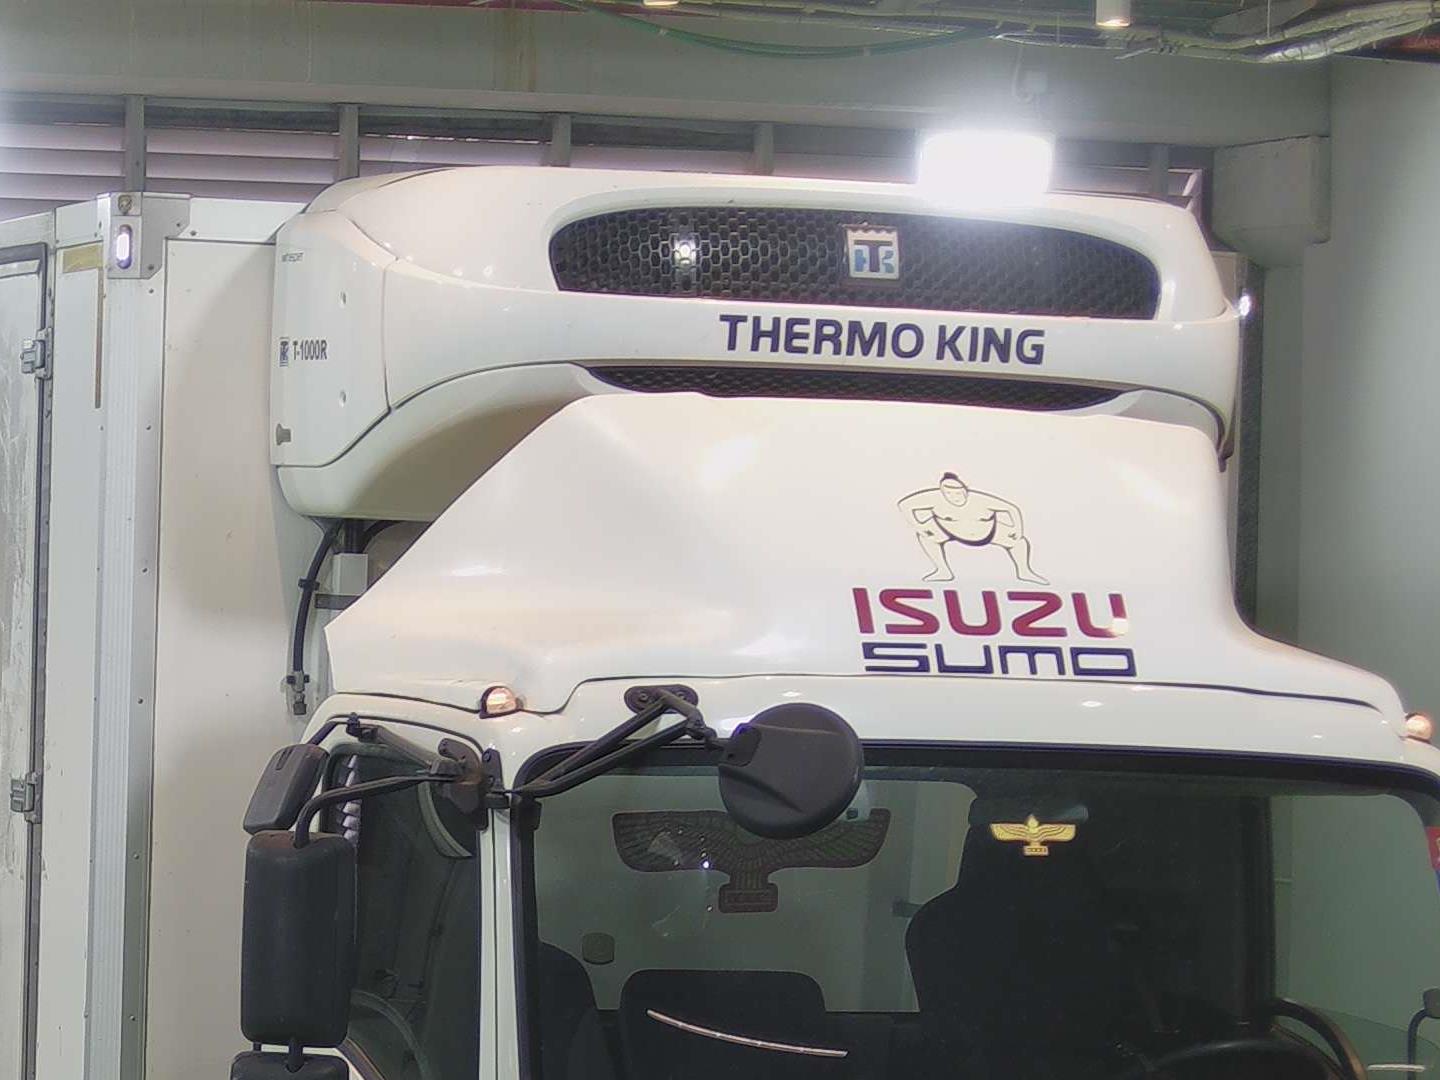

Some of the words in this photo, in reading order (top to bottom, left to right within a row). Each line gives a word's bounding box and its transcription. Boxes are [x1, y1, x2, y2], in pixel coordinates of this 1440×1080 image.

[292, 339, 328, 361] T-1000R
[719, 313, 925, 359] THERMO
[935, 324, 1046, 366] KING
[852, 587, 1129, 638] ISUZU
[861, 642, 1137, 677] SUMO
